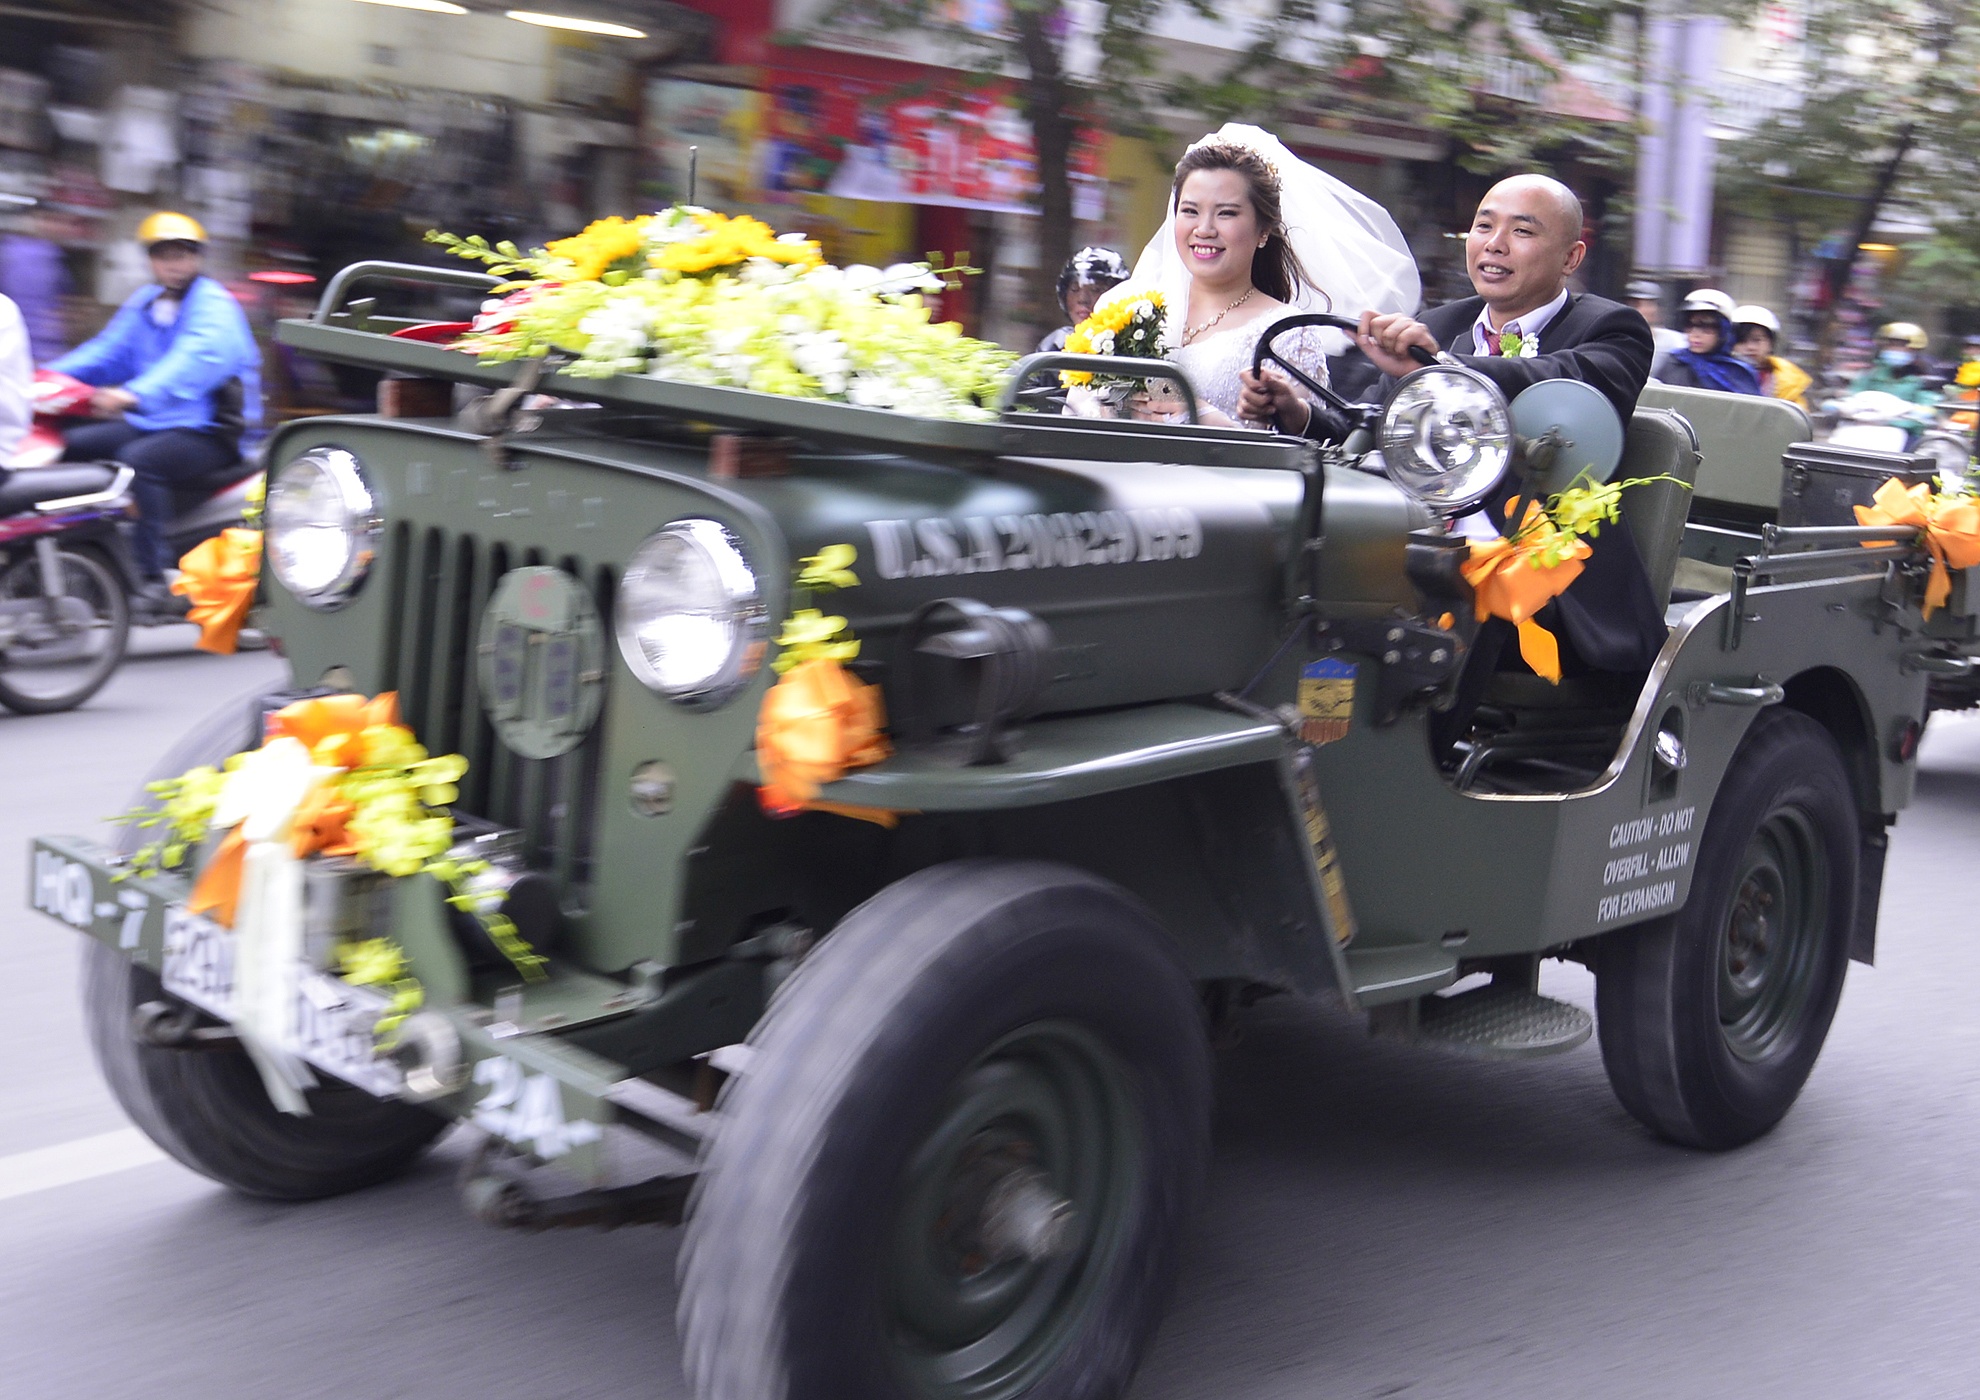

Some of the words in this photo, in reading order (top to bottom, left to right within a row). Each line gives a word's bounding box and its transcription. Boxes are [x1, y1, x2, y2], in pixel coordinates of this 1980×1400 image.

[1610, 816, 1653, 849] CAUTION
[1658, 812, 1674, 836] DO
[1674, 806, 1695, 833] NOT
[1603, 852, 1648, 886] OVERFILL
[1655, 842, 1690, 872] ALLOW
[1597, 894, 1619, 923] FOR
[1620, 880, 1675, 917] EXPANSION
